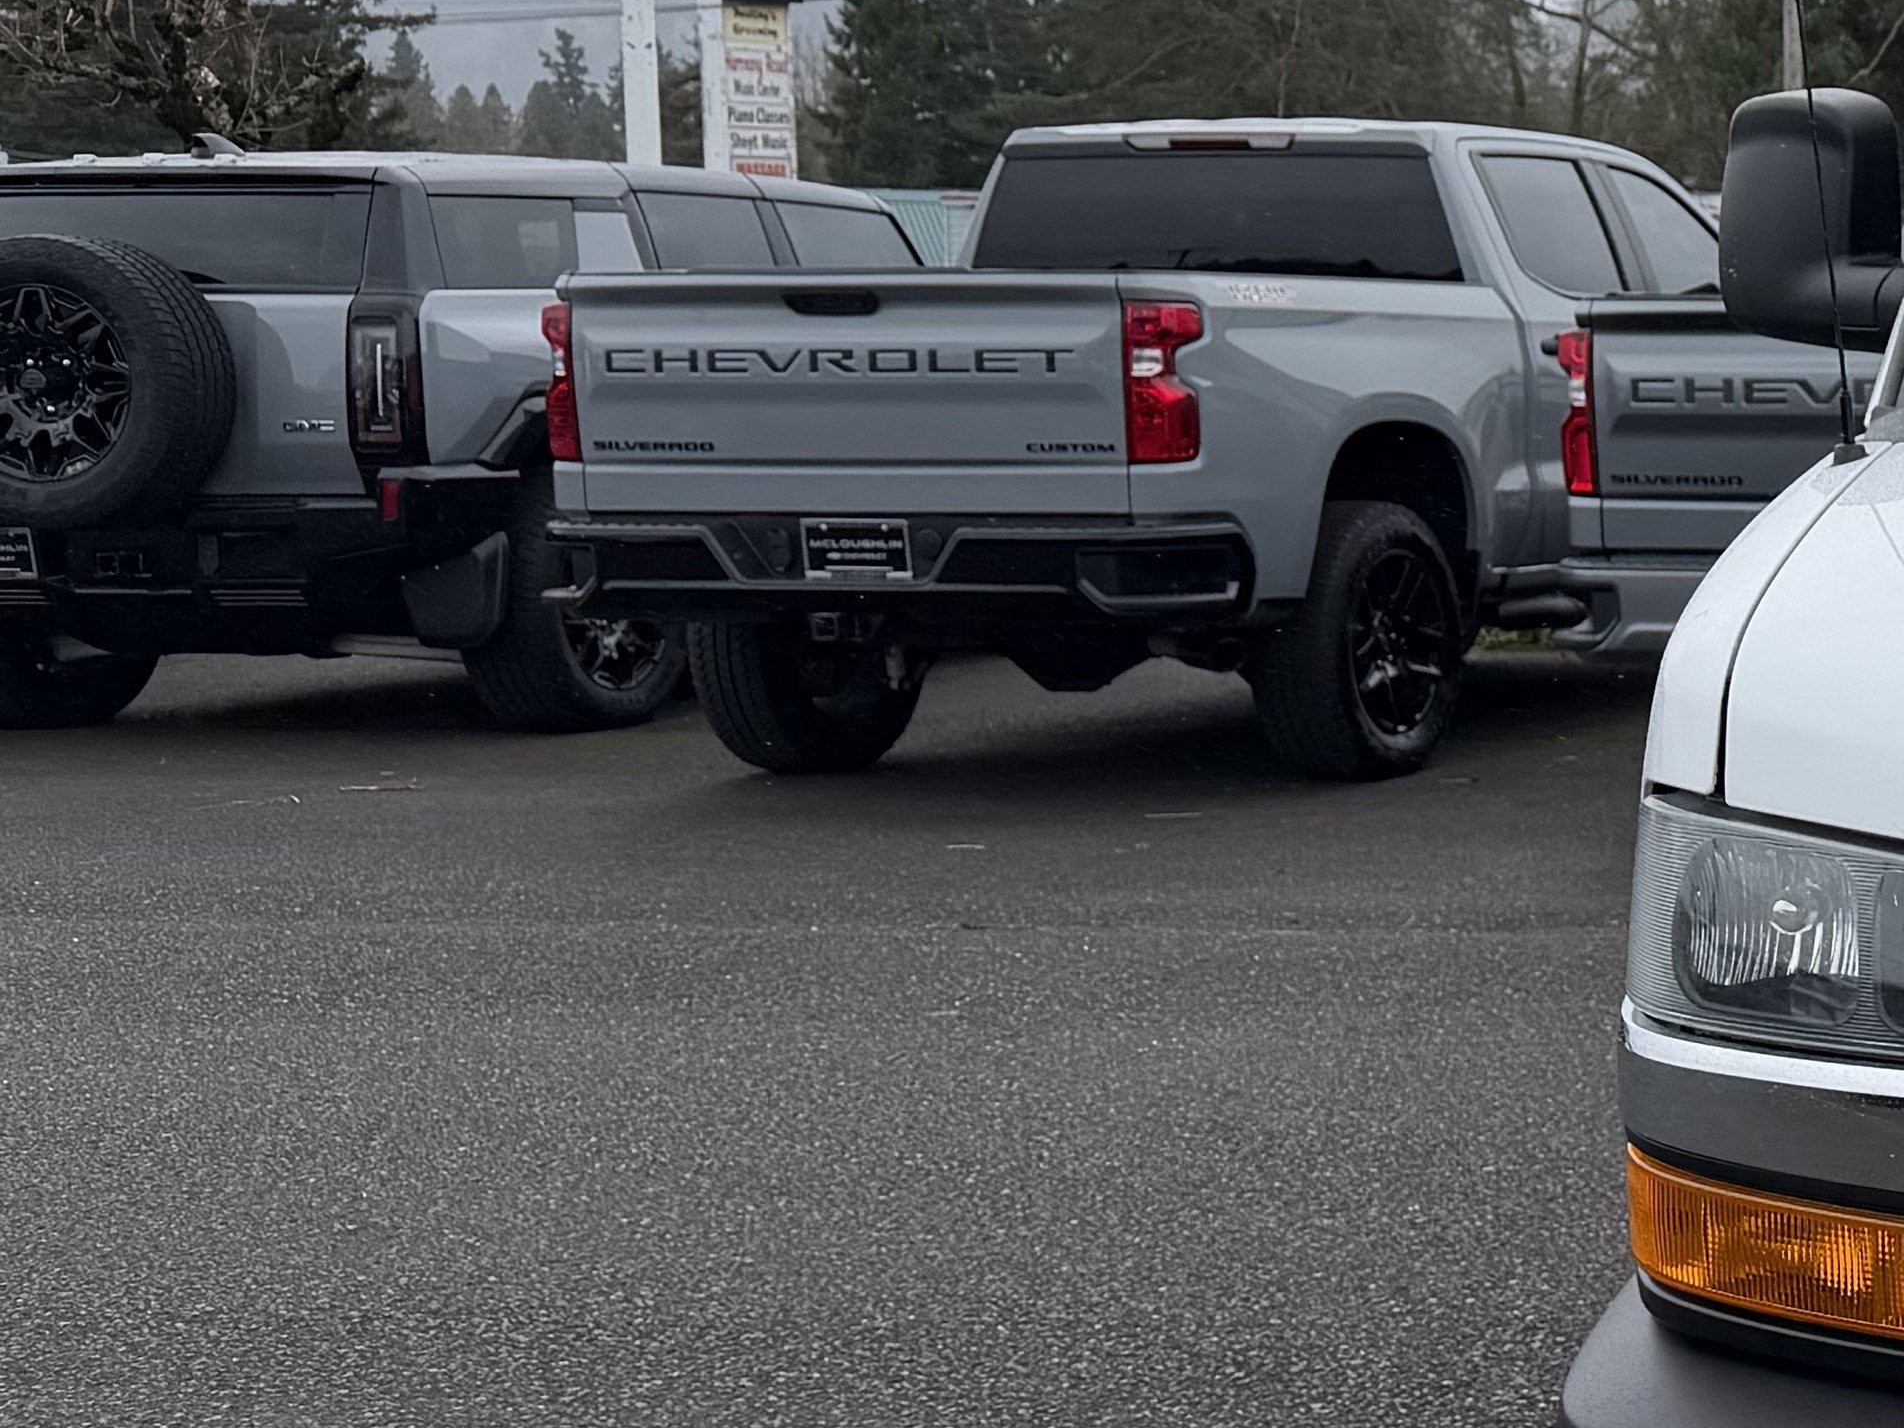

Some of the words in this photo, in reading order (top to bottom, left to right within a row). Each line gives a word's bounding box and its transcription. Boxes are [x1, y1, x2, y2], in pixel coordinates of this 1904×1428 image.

[605, 348, 1074, 373] CHEVROLET
[593, 440, 715, 452] SILVERADO
[1026, 442, 1115, 454] CUSTOM
[1610, 474, 1743, 487] SILVERADO
